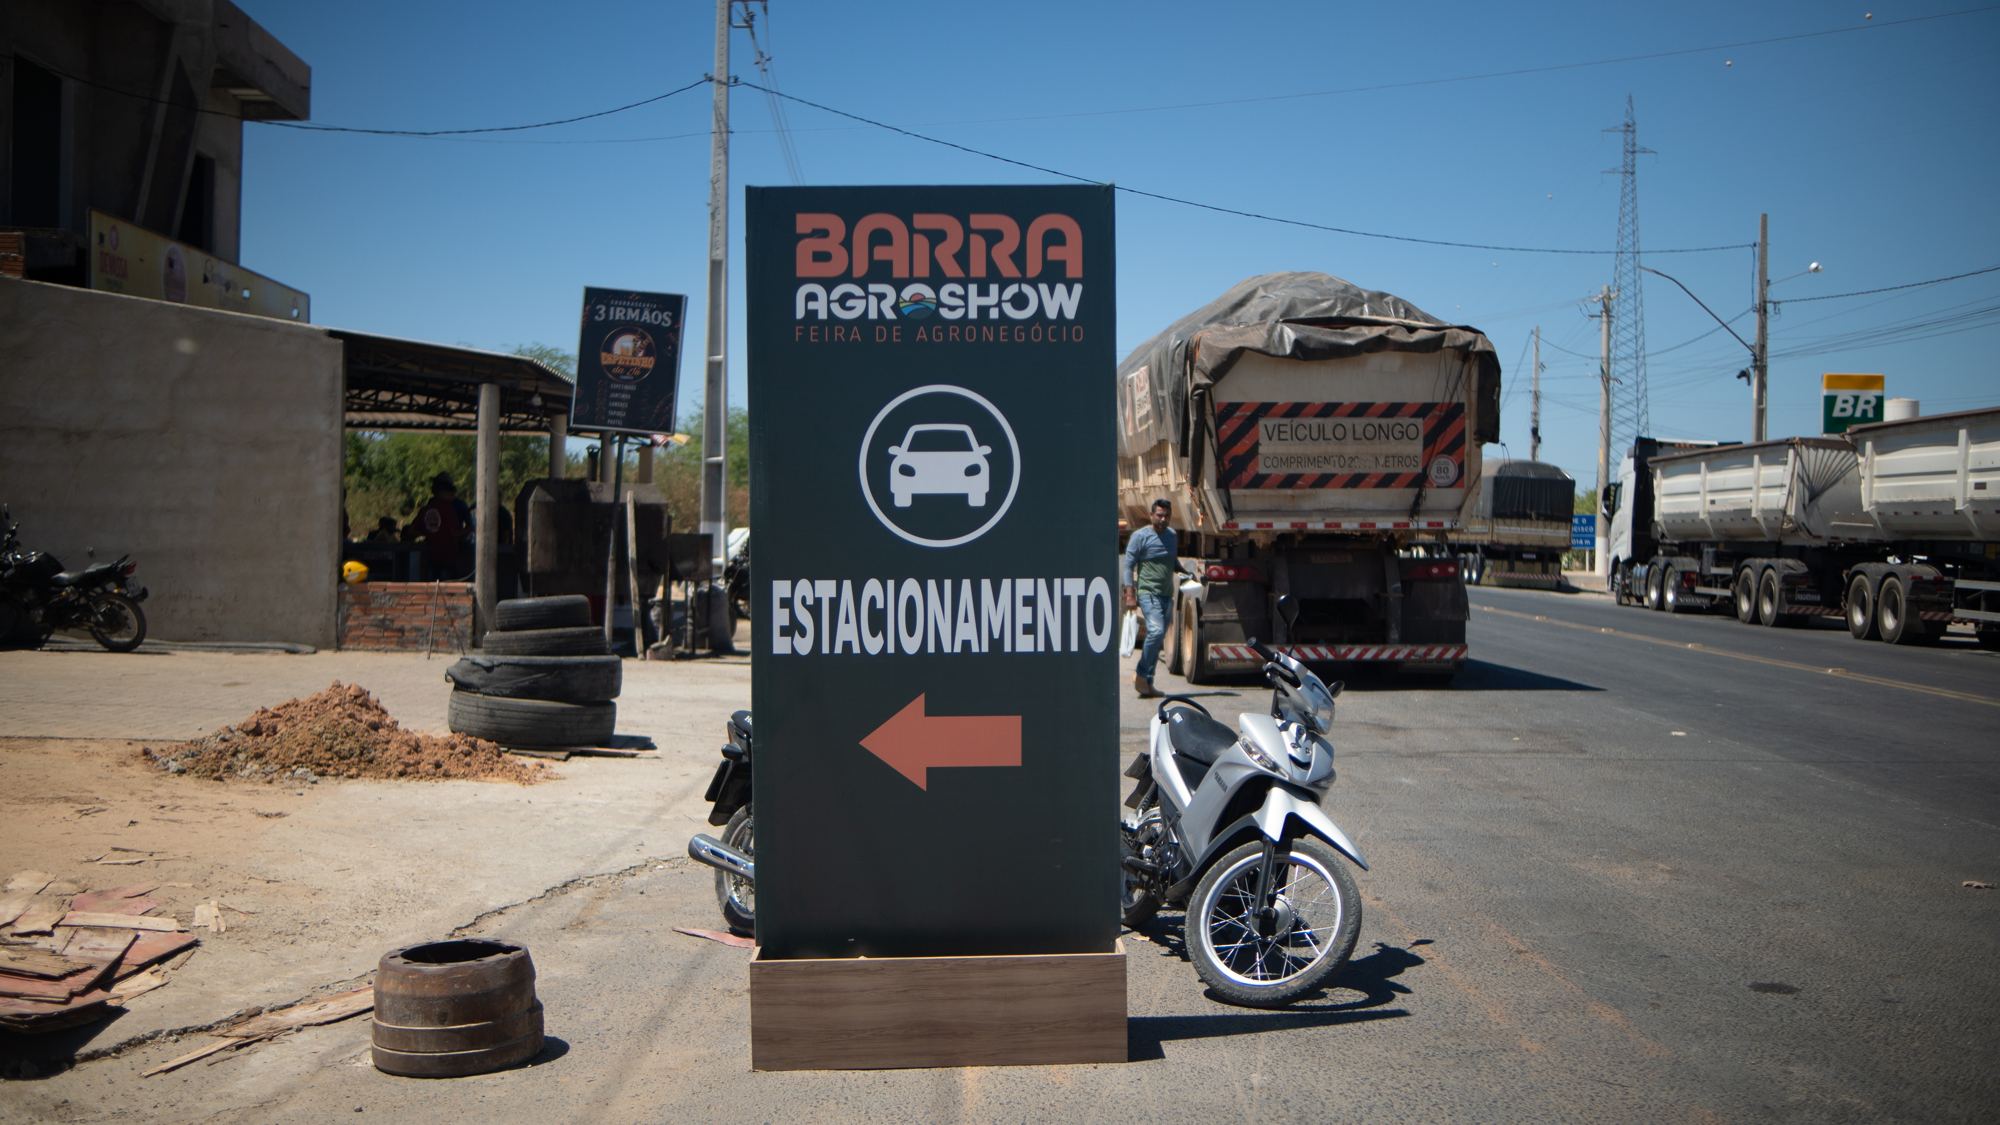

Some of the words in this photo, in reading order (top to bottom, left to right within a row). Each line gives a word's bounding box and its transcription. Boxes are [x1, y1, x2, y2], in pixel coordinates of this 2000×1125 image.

[795, 213, 1084, 278] BARRA
[594, 305, 606, 321] 3
[608, 307, 673, 327] IRMÃOS
[795, 325, 862, 343] FEIRA
[875, 325, 902, 343] DE
[915, 324, 1084, 343] AGRONEGÓCIO
[1832, 394, 1877, 418] BR
[1264, 420, 1347, 442] VEÍCULO
[1352, 423, 1420, 441] LONGO
[1263, 455, 1346, 469] COMPRIMENTO
[772, 576, 1112, 656] ESTACIONAMENTO
